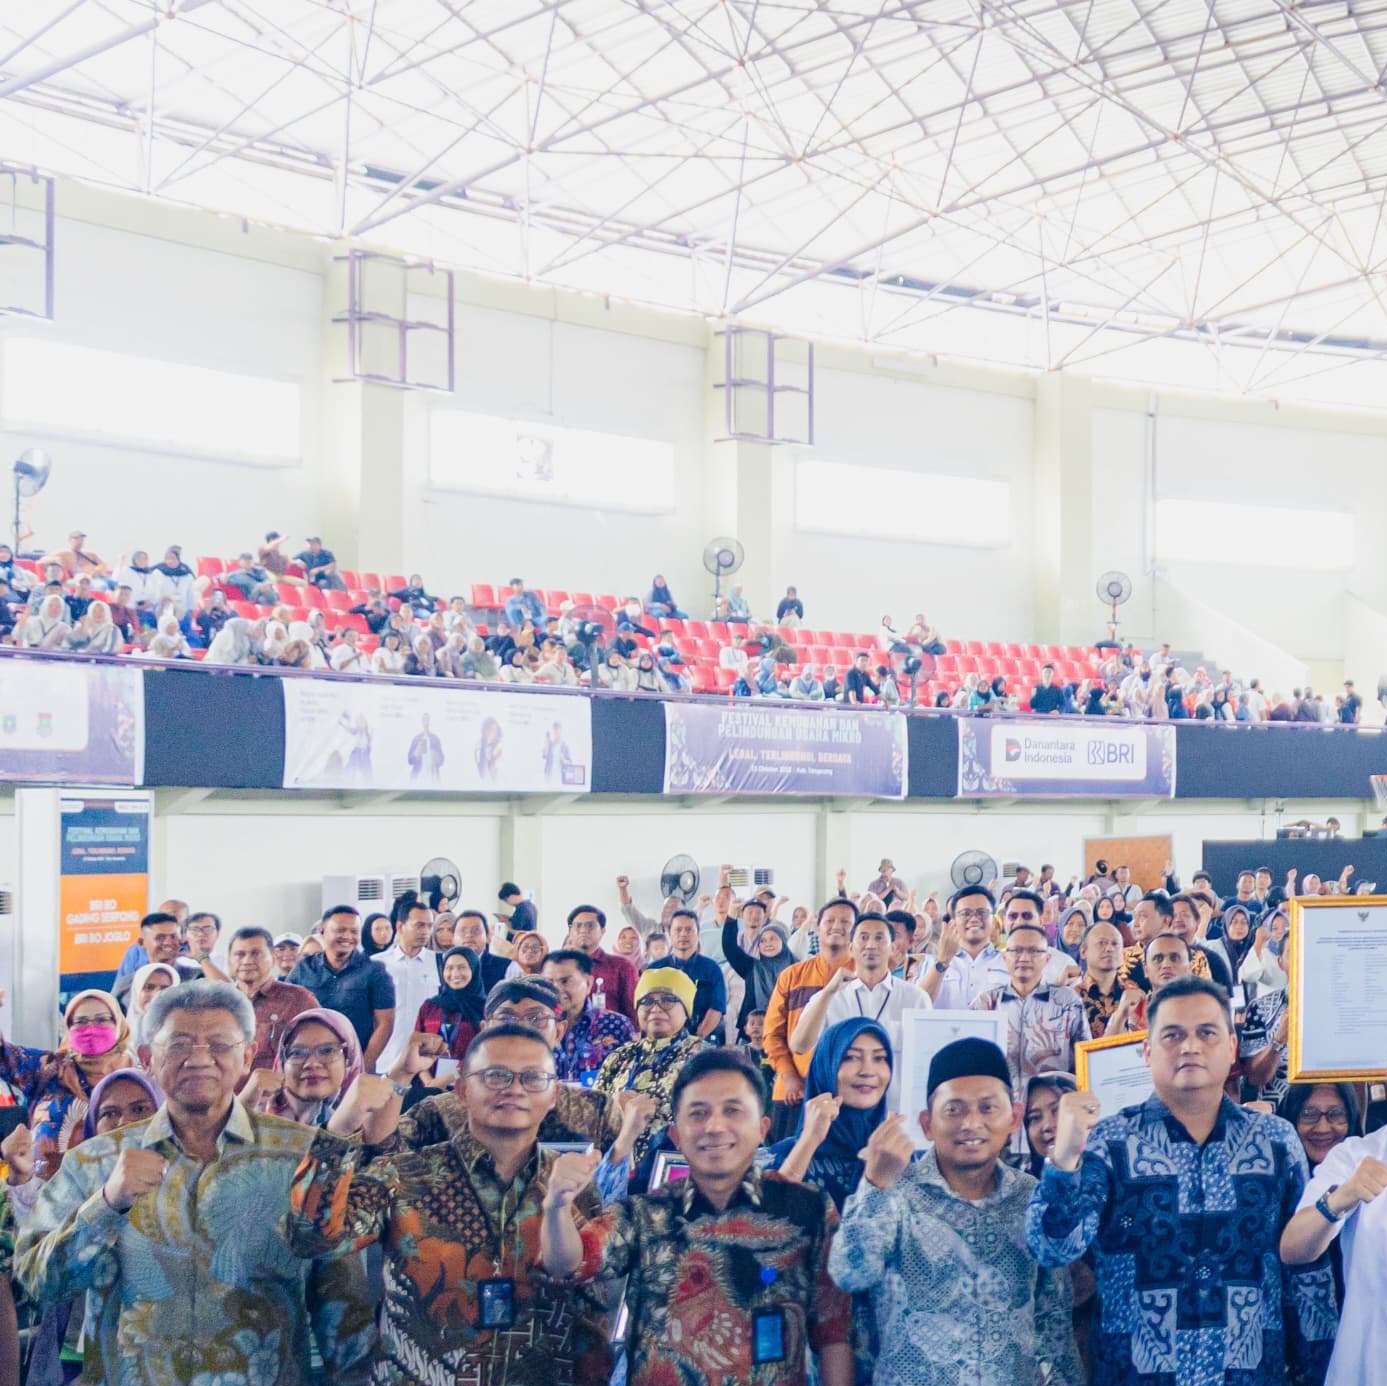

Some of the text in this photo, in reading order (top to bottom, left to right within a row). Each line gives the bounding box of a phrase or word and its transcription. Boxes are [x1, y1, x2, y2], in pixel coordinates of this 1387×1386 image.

[721, 712, 773, 728] FESTIVAL
[1024, 738, 1075, 750] Danantara
[1024, 751, 1072, 764] Indonesia
[1107, 743, 1134, 764] BRI
